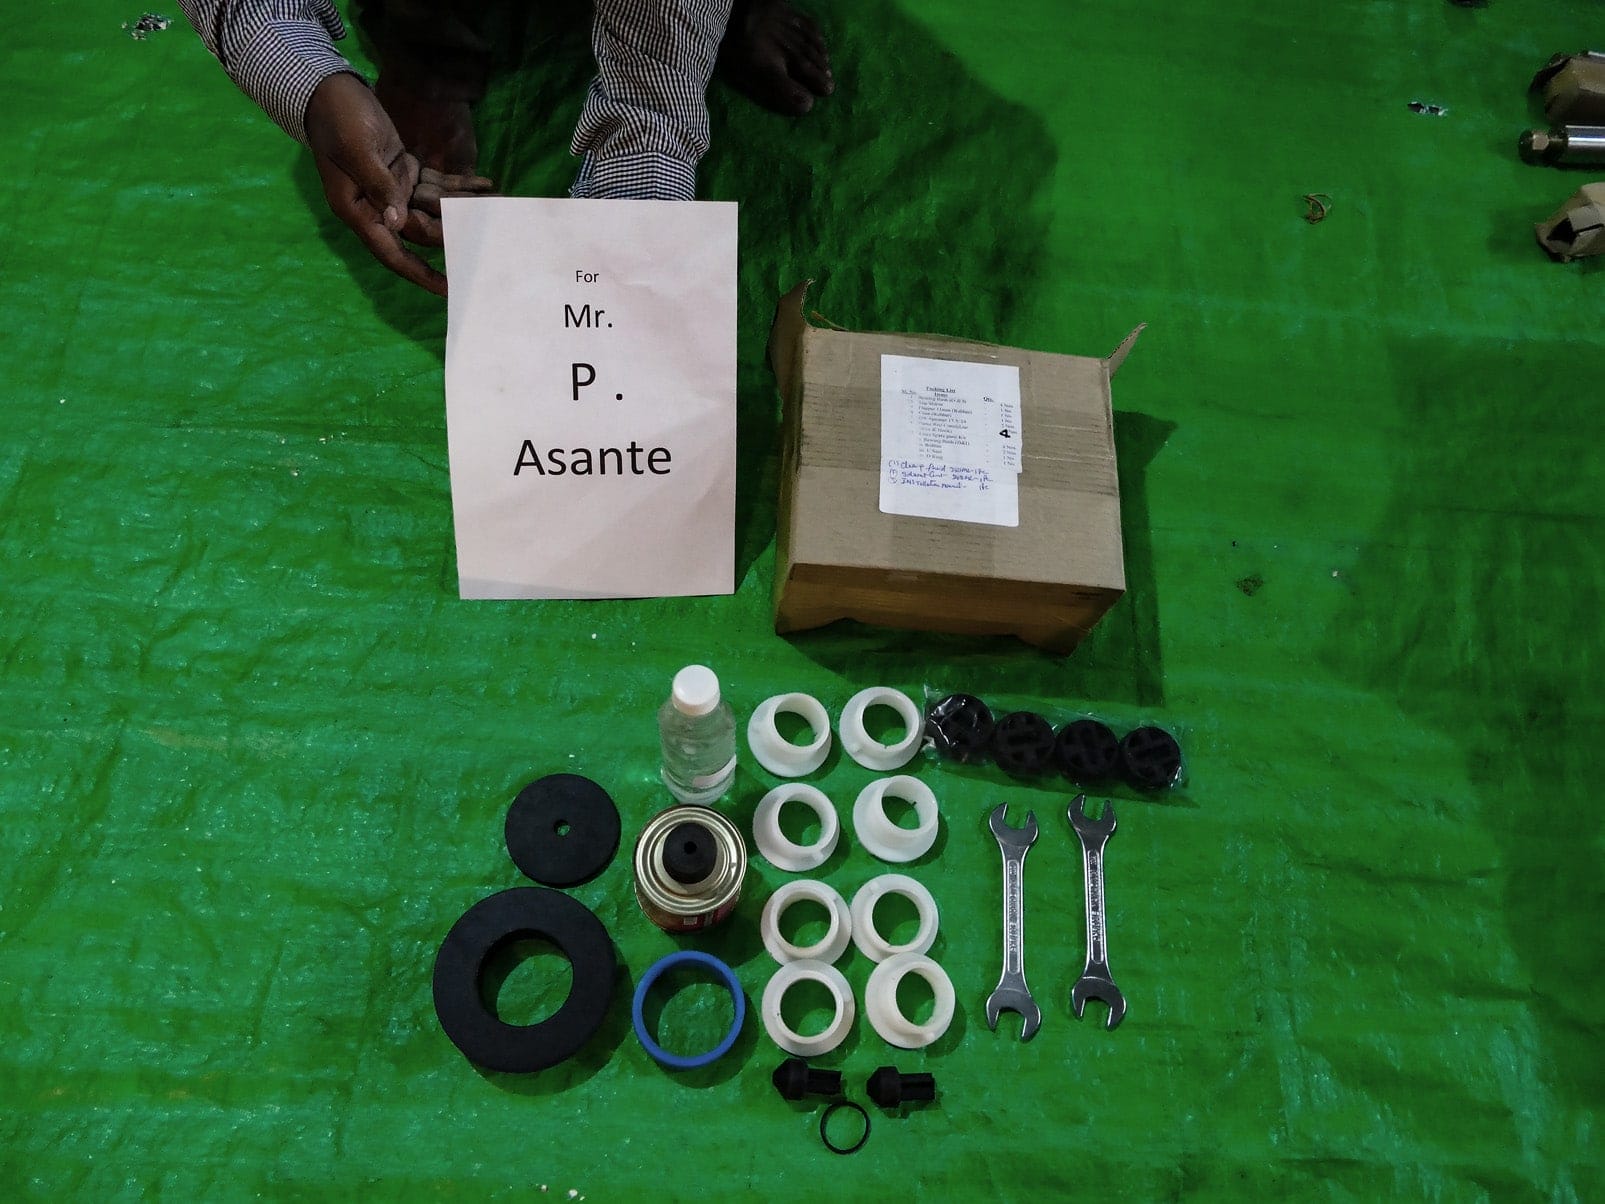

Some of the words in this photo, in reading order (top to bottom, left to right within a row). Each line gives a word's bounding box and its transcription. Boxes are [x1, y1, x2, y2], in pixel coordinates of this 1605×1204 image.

[575, 270, 600, 284] For
[564, 304, 613, 328] Mr.
[513, 439, 672, 476] Asante
